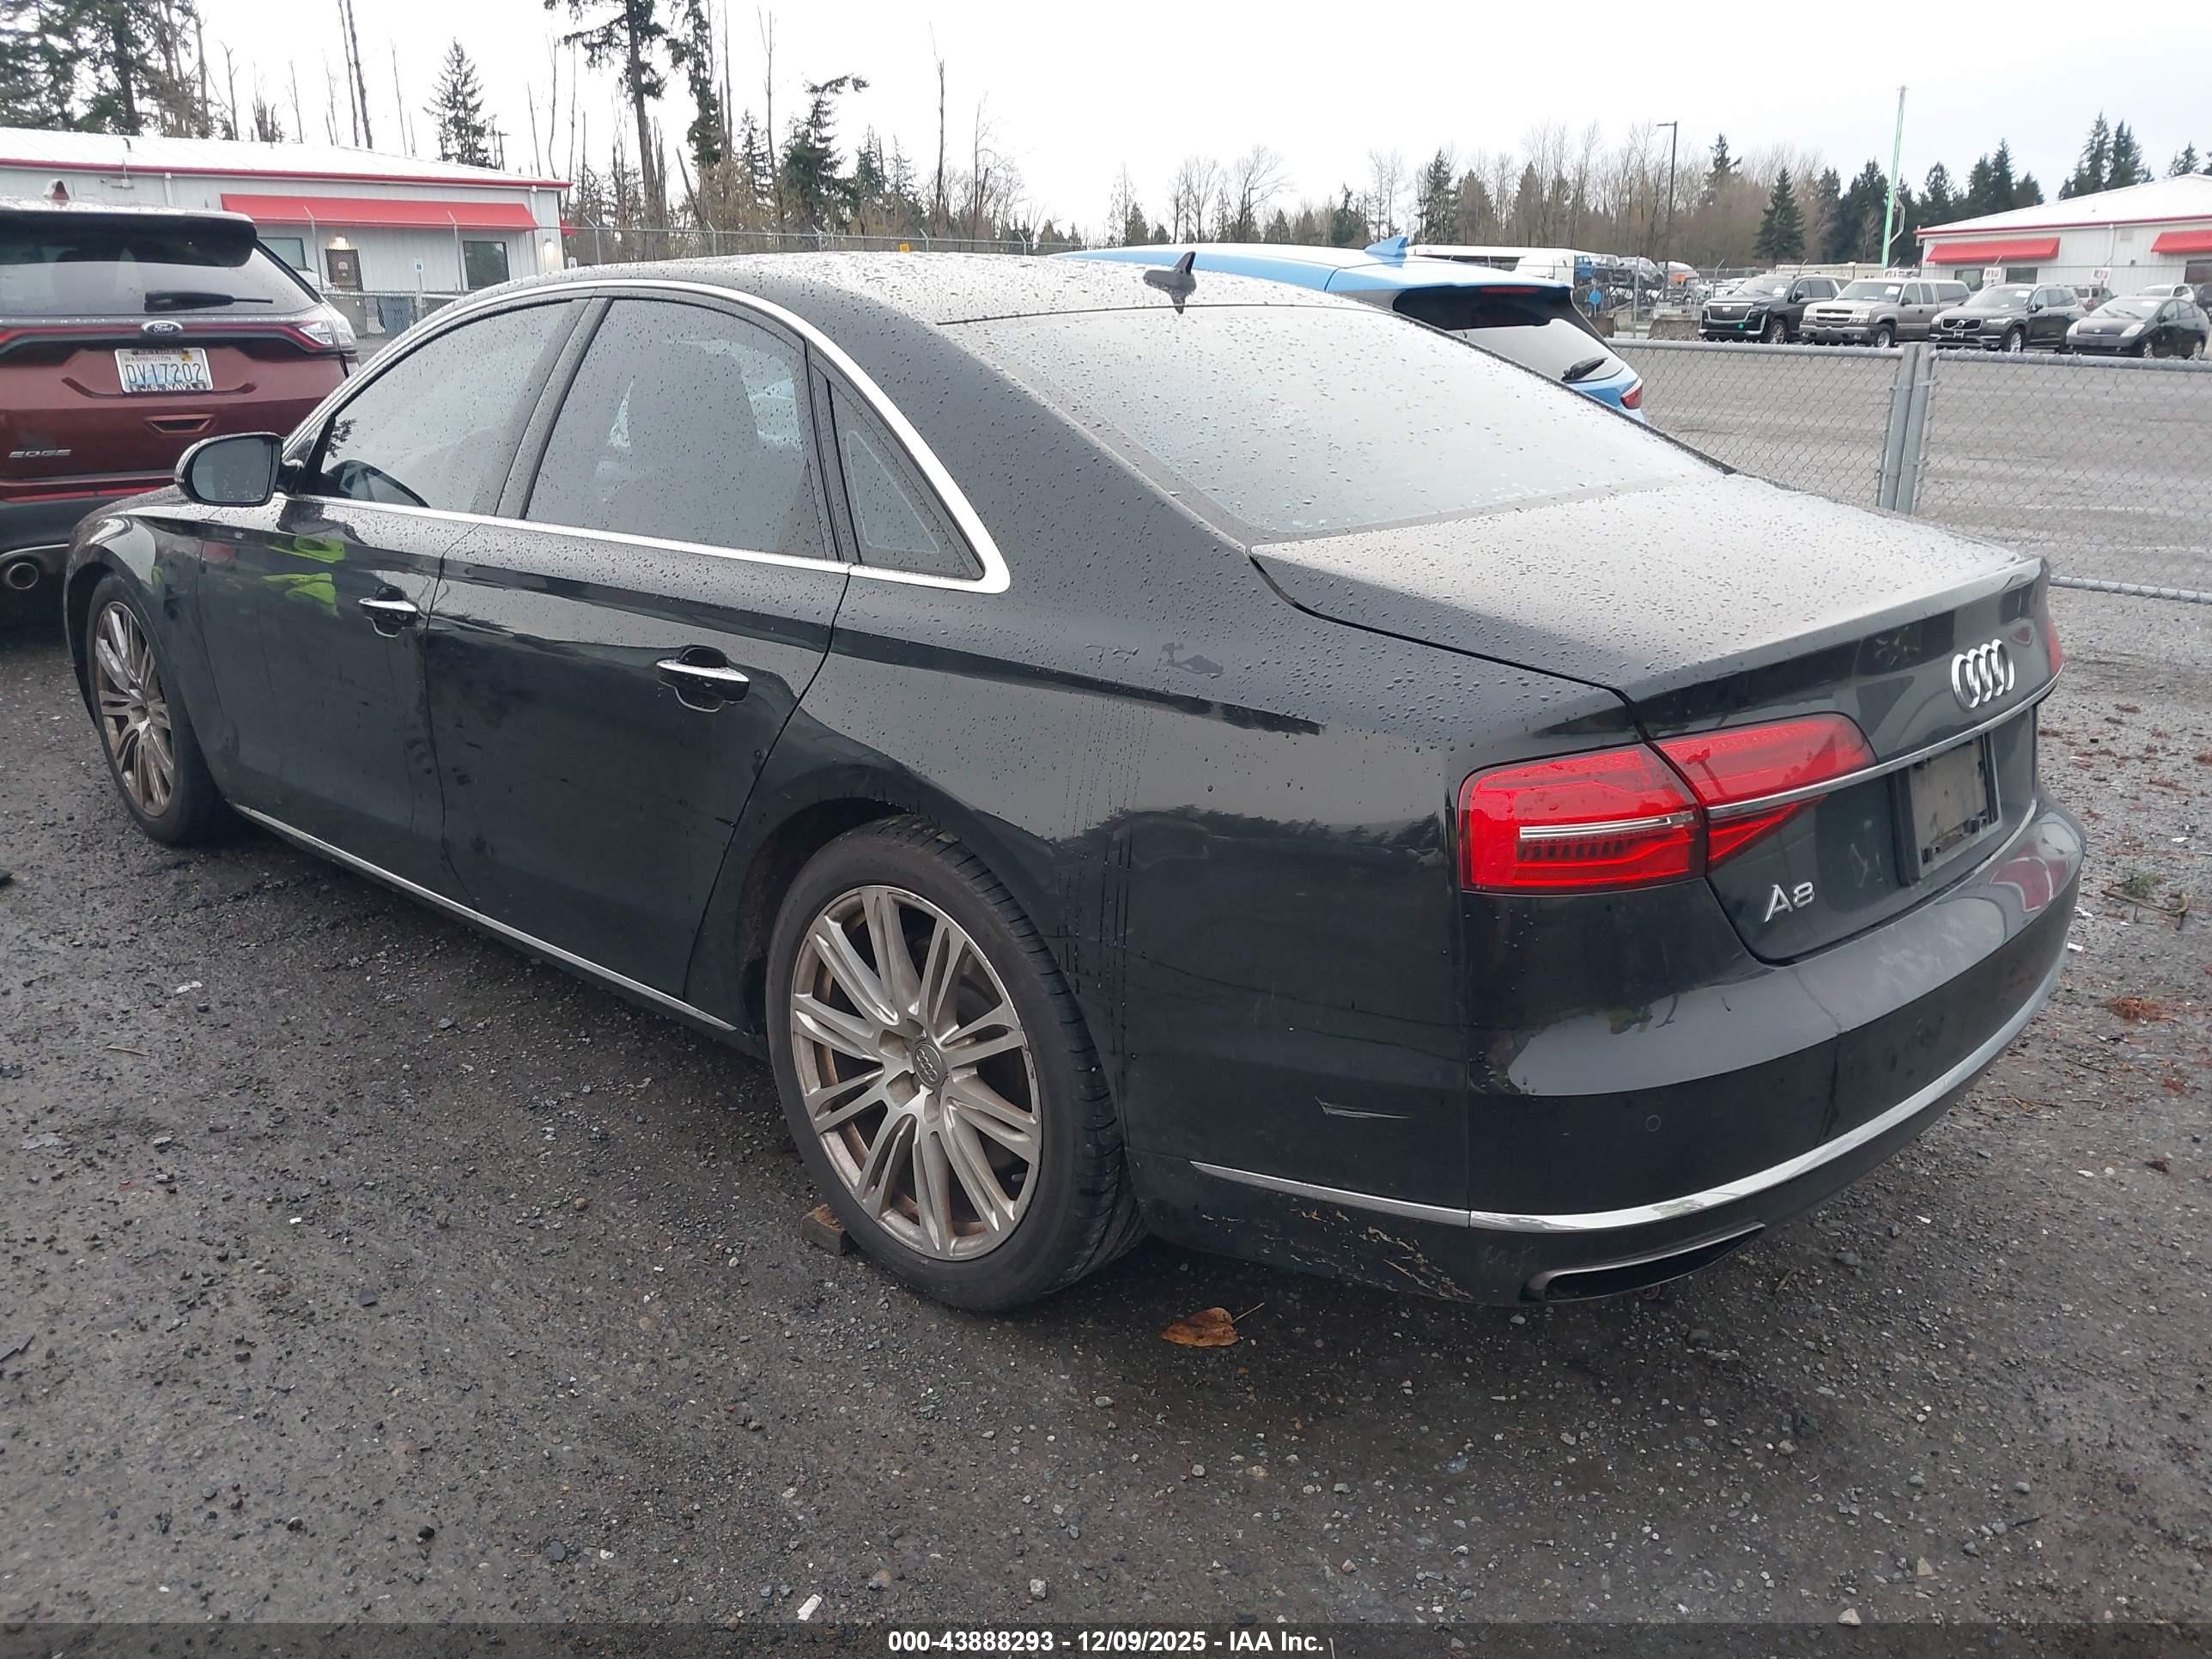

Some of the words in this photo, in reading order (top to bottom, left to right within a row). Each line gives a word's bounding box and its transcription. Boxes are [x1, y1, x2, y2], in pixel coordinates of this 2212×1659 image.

[125, 362, 205, 384] DV17202
[166, 383, 193, 392] NAVY
[9, 448, 72, 459] EDGE
[1764, 881, 1815, 923] A8
